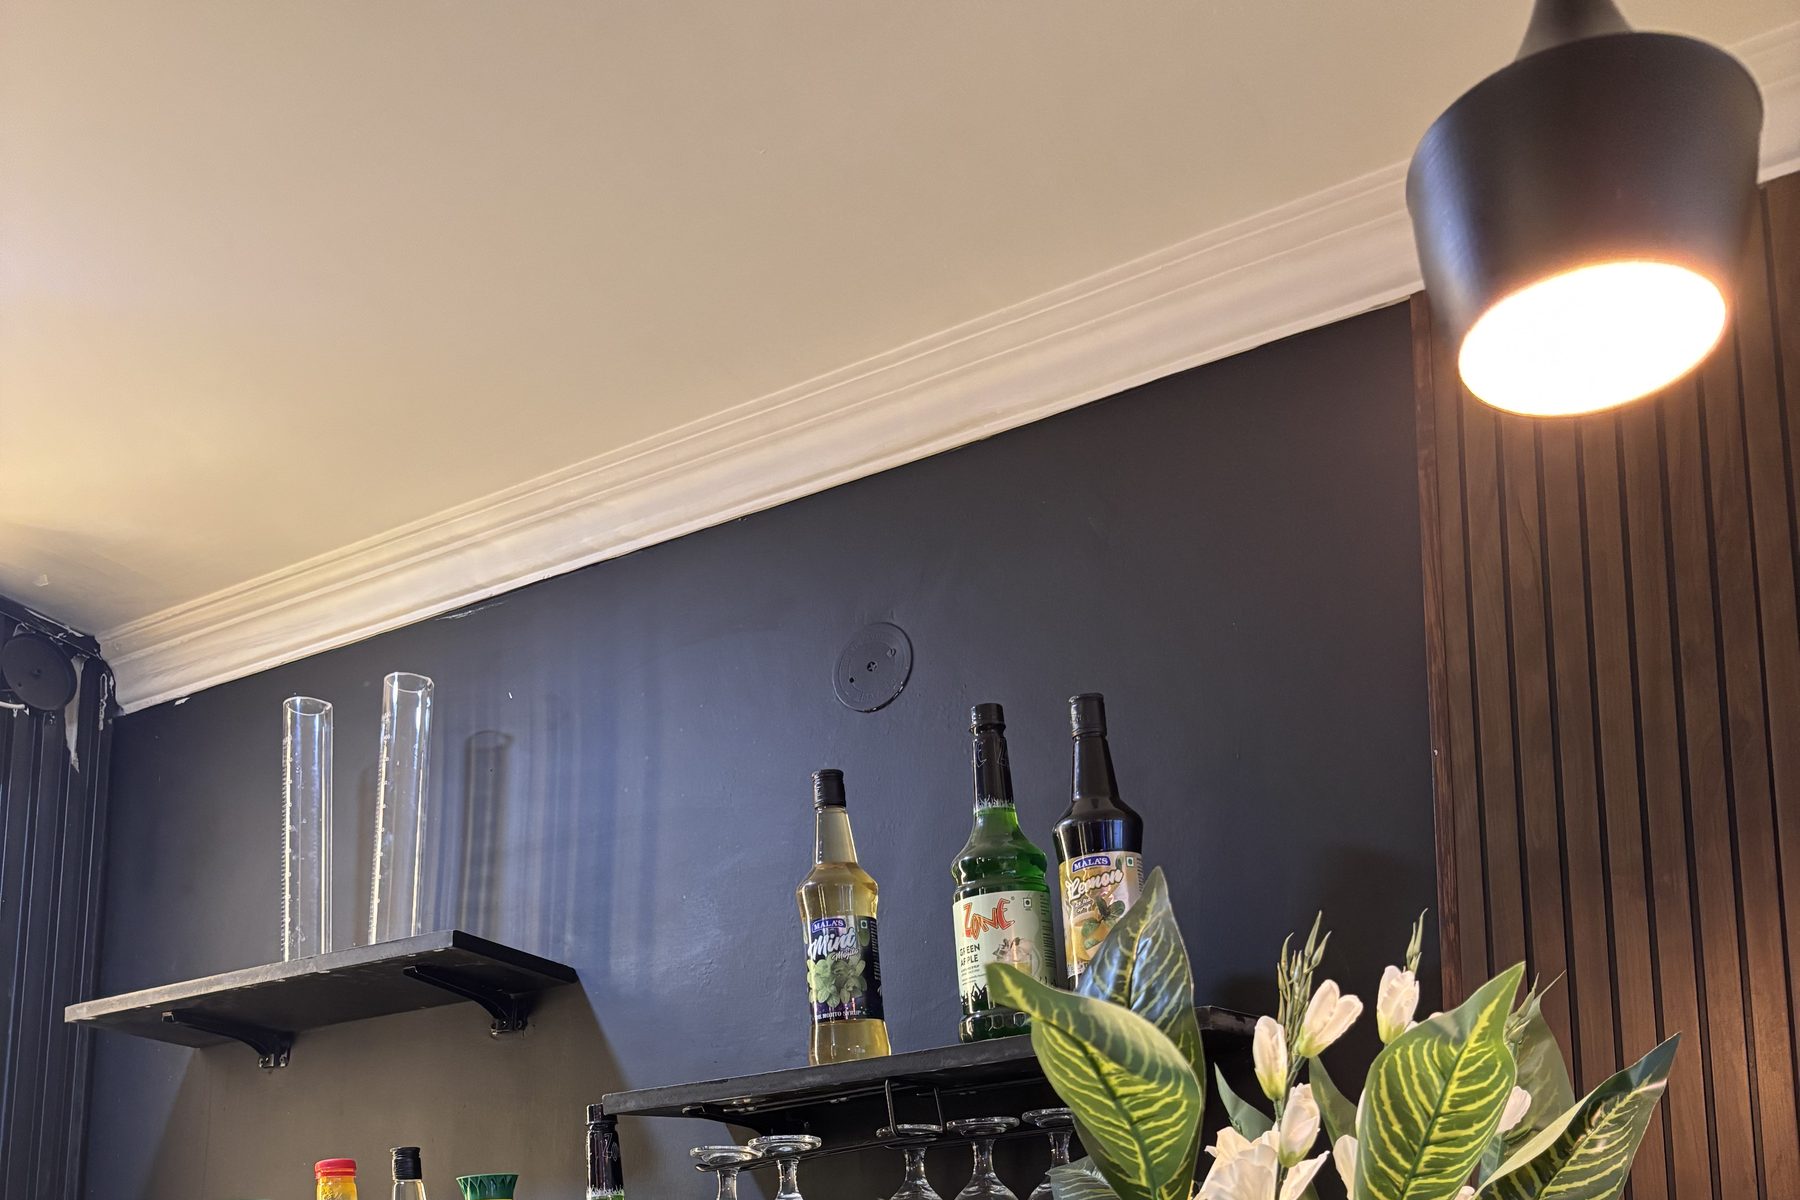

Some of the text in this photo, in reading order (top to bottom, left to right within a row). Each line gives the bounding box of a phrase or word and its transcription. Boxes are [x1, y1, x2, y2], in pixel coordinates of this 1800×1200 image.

[1073, 857, 1109, 870] MALA'S
[1065, 869, 1124, 900] Lemon
[814, 920, 844, 931] MALA'S
[808, 927, 857, 961] Mint
